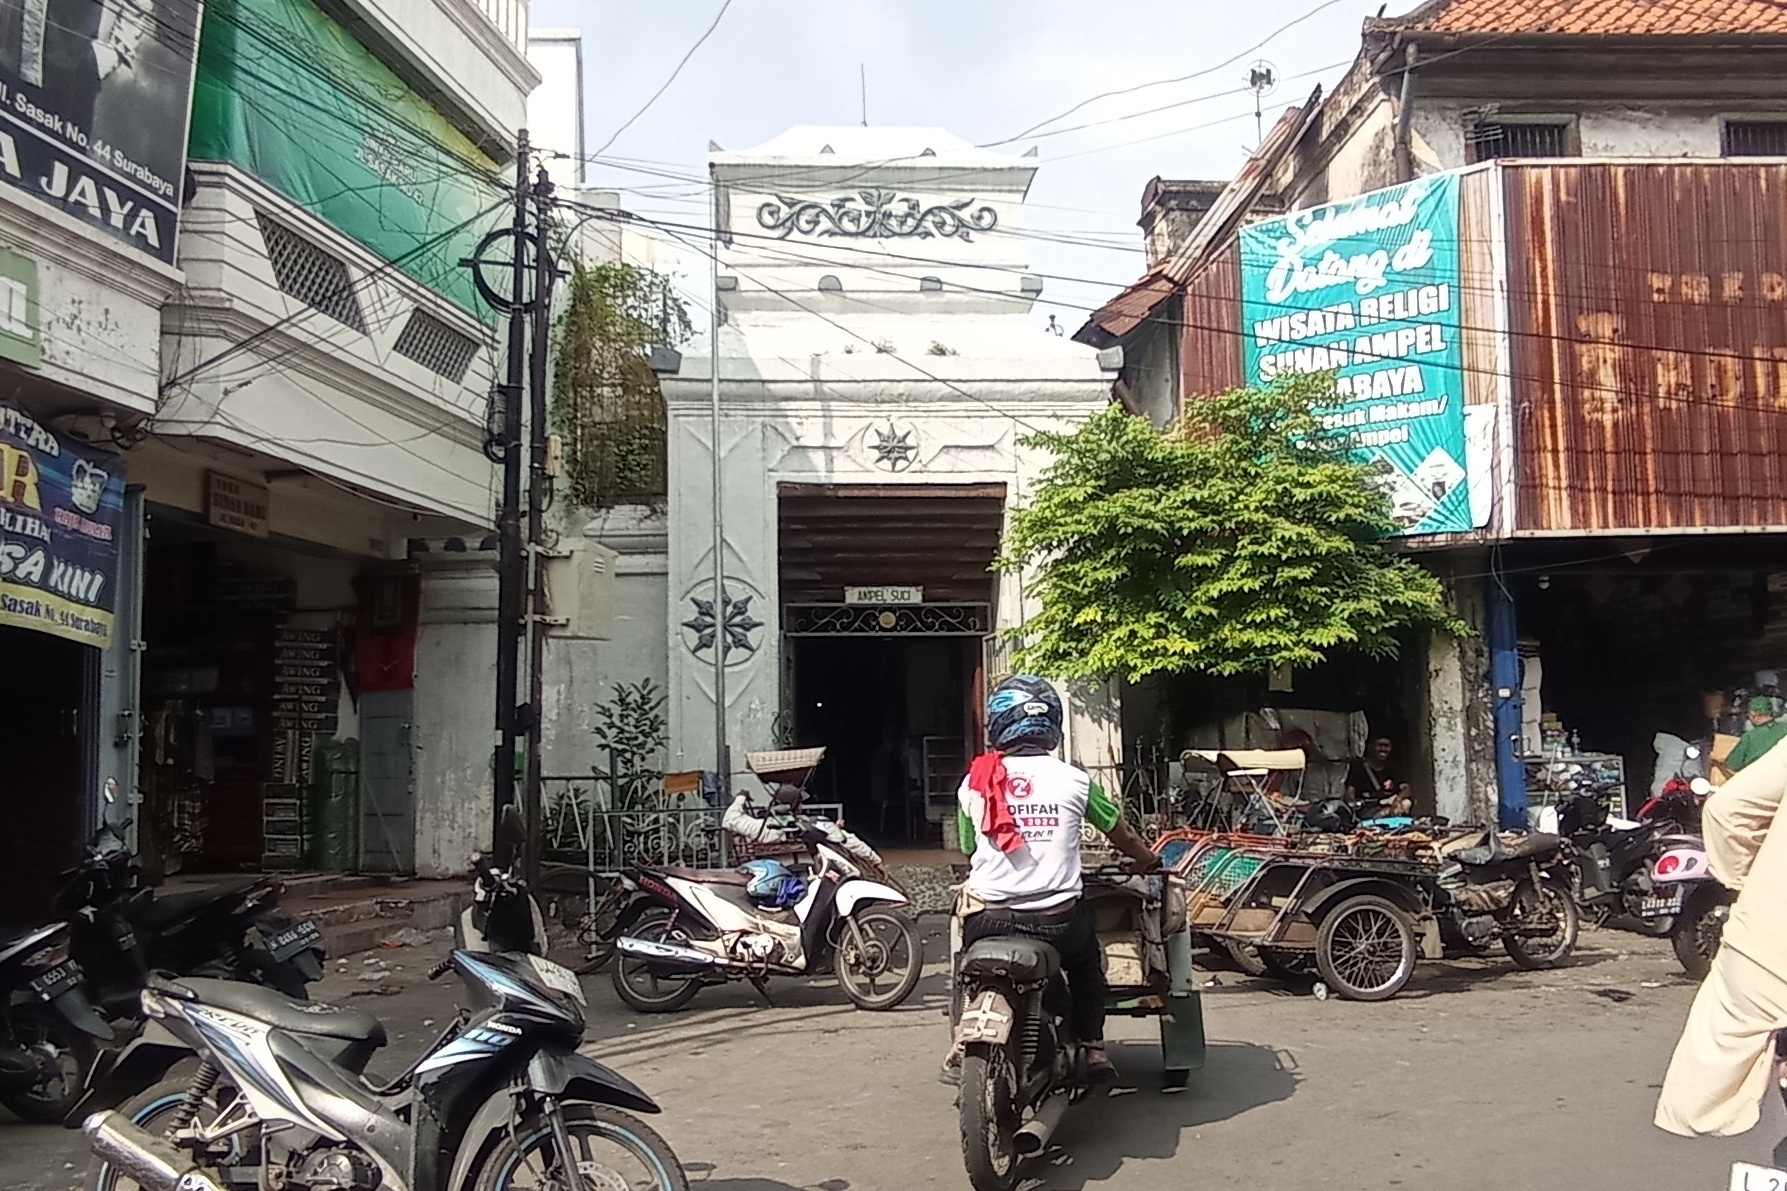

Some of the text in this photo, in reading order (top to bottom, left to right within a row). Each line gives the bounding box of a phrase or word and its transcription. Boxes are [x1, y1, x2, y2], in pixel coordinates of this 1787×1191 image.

[15, 93, 63, 135] Sasak
[66, 121, 91, 150] No.
[93, 140, 111, 161] 44
[113, 150, 174, 198] Surabaya
[41, 160, 161, 249] JAYA
[1254, 284, 1450, 348] WISATA RELIGI
[1259, 324, 1447, 382] SUNAN AMPEL
[49, 557, 104, 602] KINI
[487, 1020, 523, 1036] HONDA
